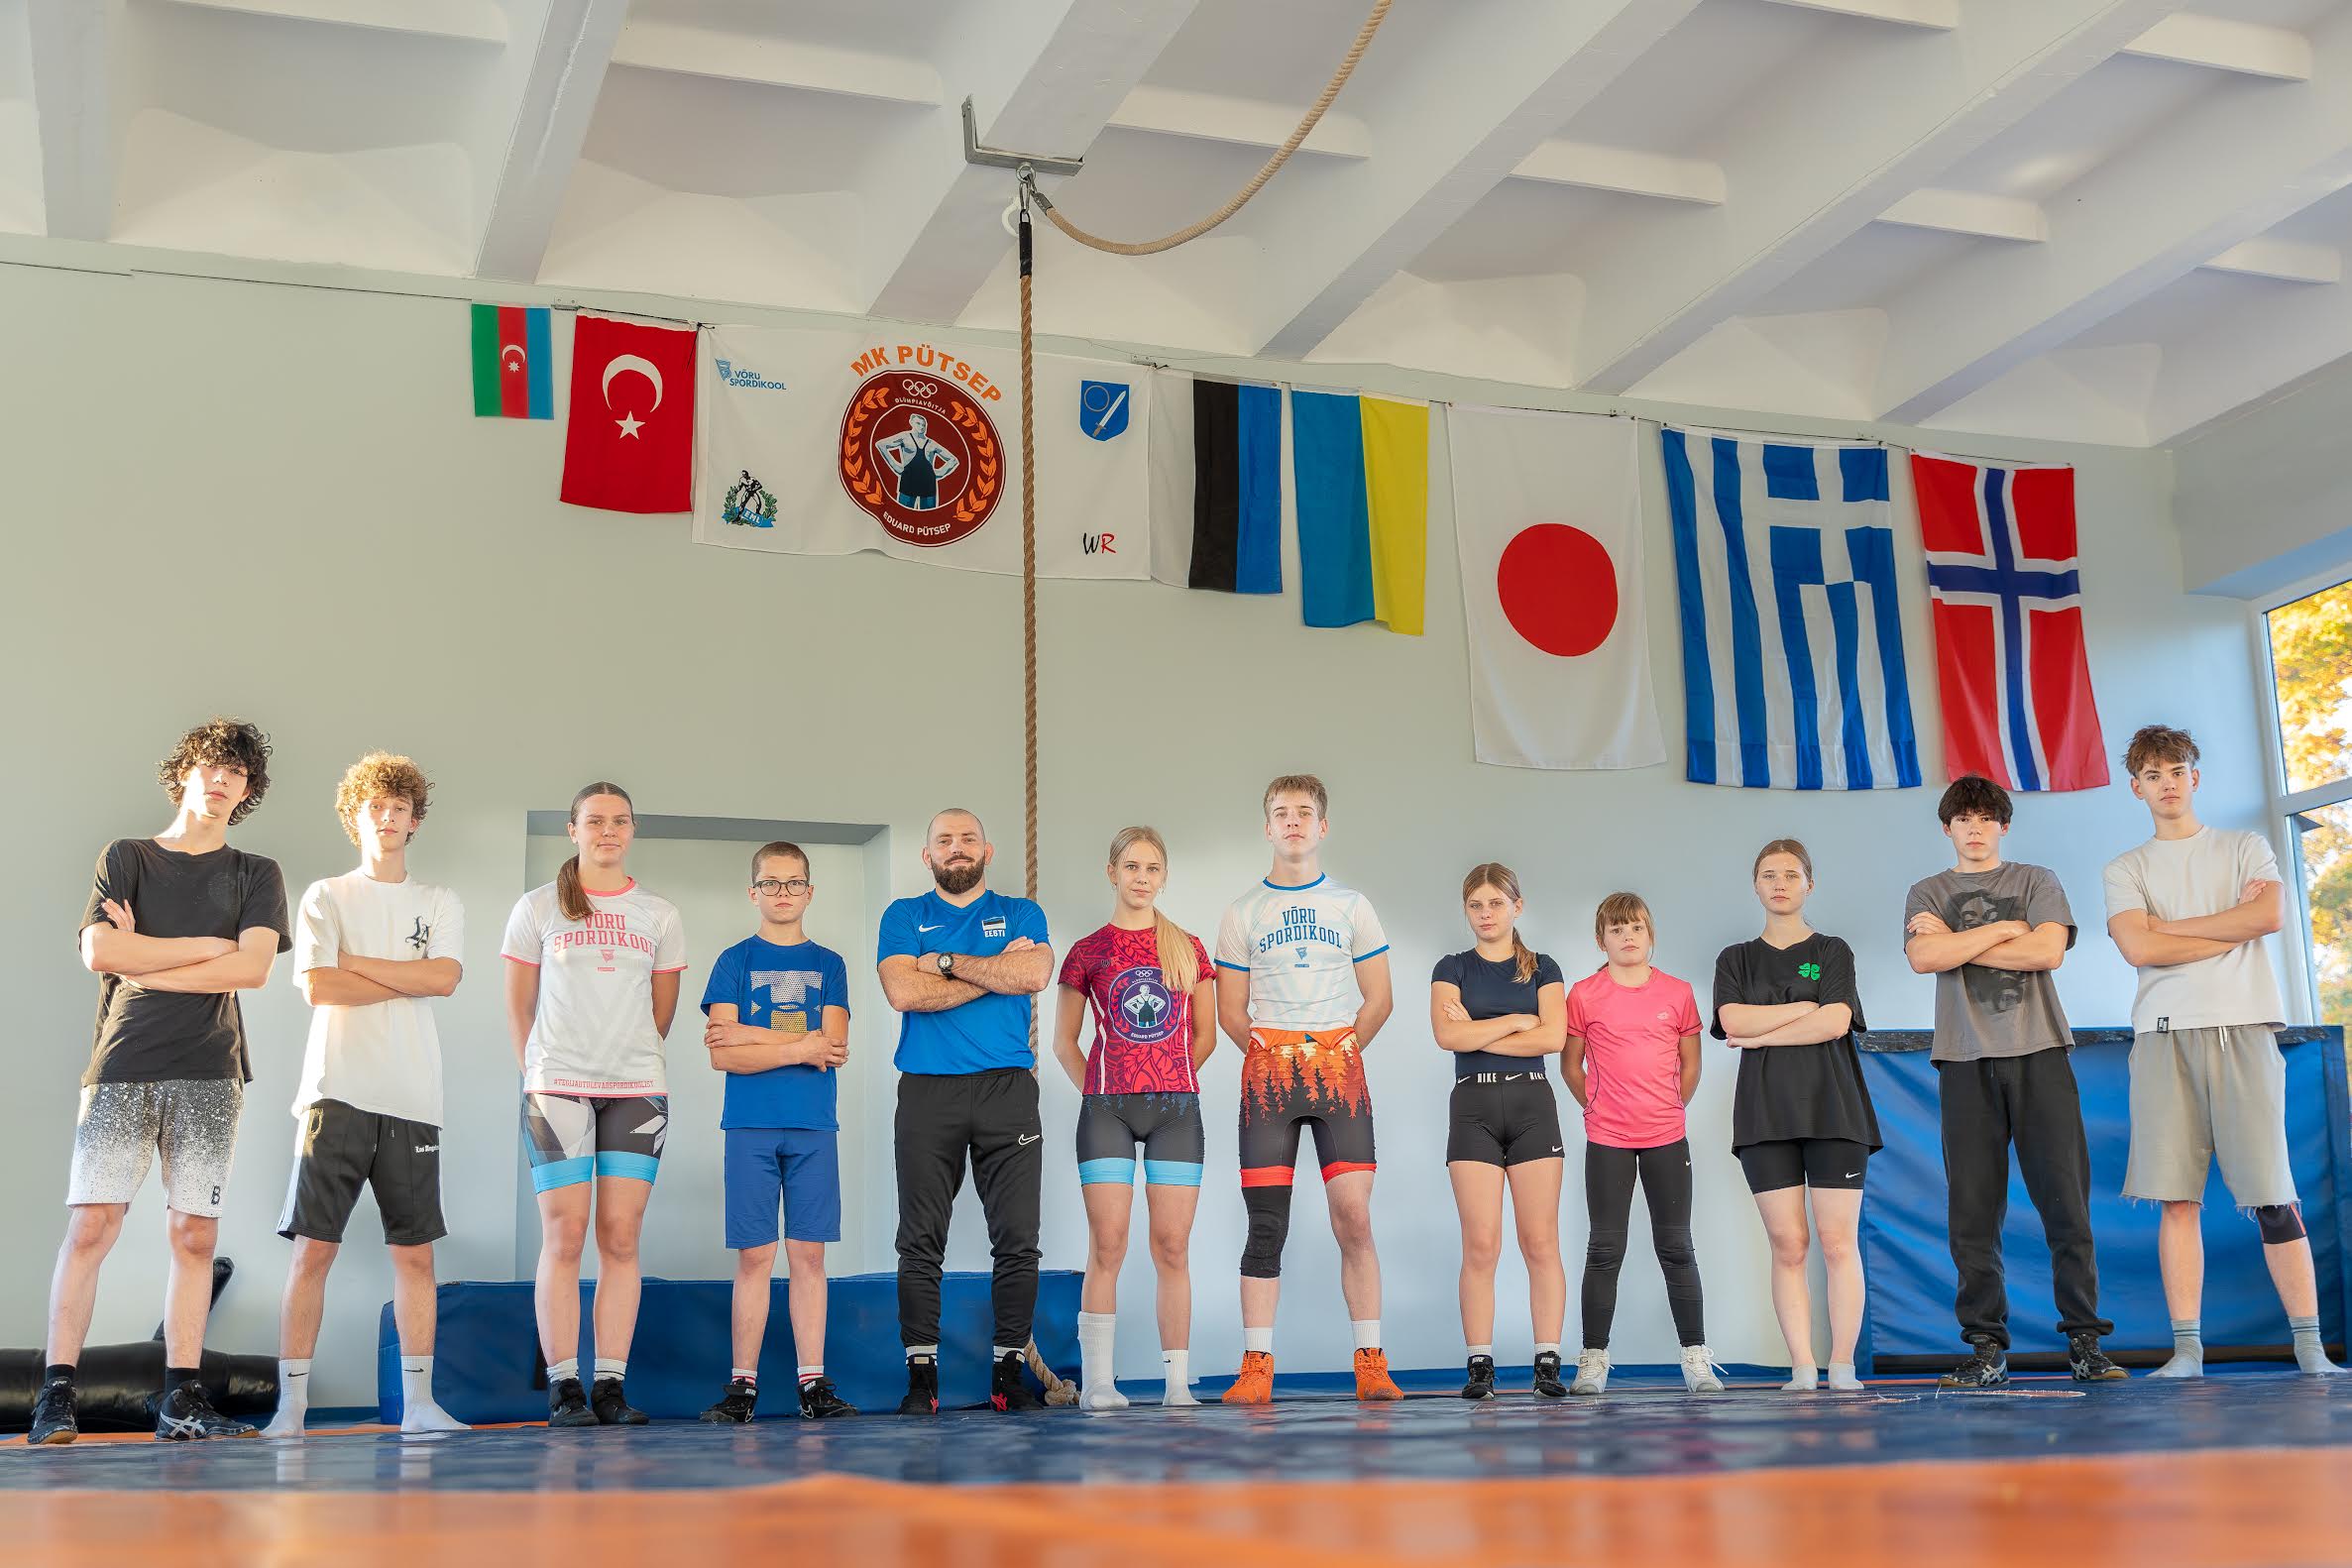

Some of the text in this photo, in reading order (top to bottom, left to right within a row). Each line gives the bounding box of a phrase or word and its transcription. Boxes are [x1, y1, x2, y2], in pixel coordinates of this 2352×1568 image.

[734, 369, 760, 380] VÕRU
[850, 343, 1002, 401] MK PÜTSEP
[729, 378, 787, 391] SPORDIKOOL
[894, 396, 947, 414] OLÜMPIAVÕITJA
[883, 511, 951, 535] EDUARD PÜTSEP
[1082, 532, 1116, 555] WR
[585, 910, 625, 930] VÕRU
[1282, 906, 1316, 926] VÕRU
[984, 929, 1005, 938] EESTI
[1259, 925, 1342, 953] SPORDIKOOL
[554, 931, 654, 958] SPORDIKOOL
[1477, 1072, 1497, 1083] NIKE
[211, 1185, 220, 1205] B
